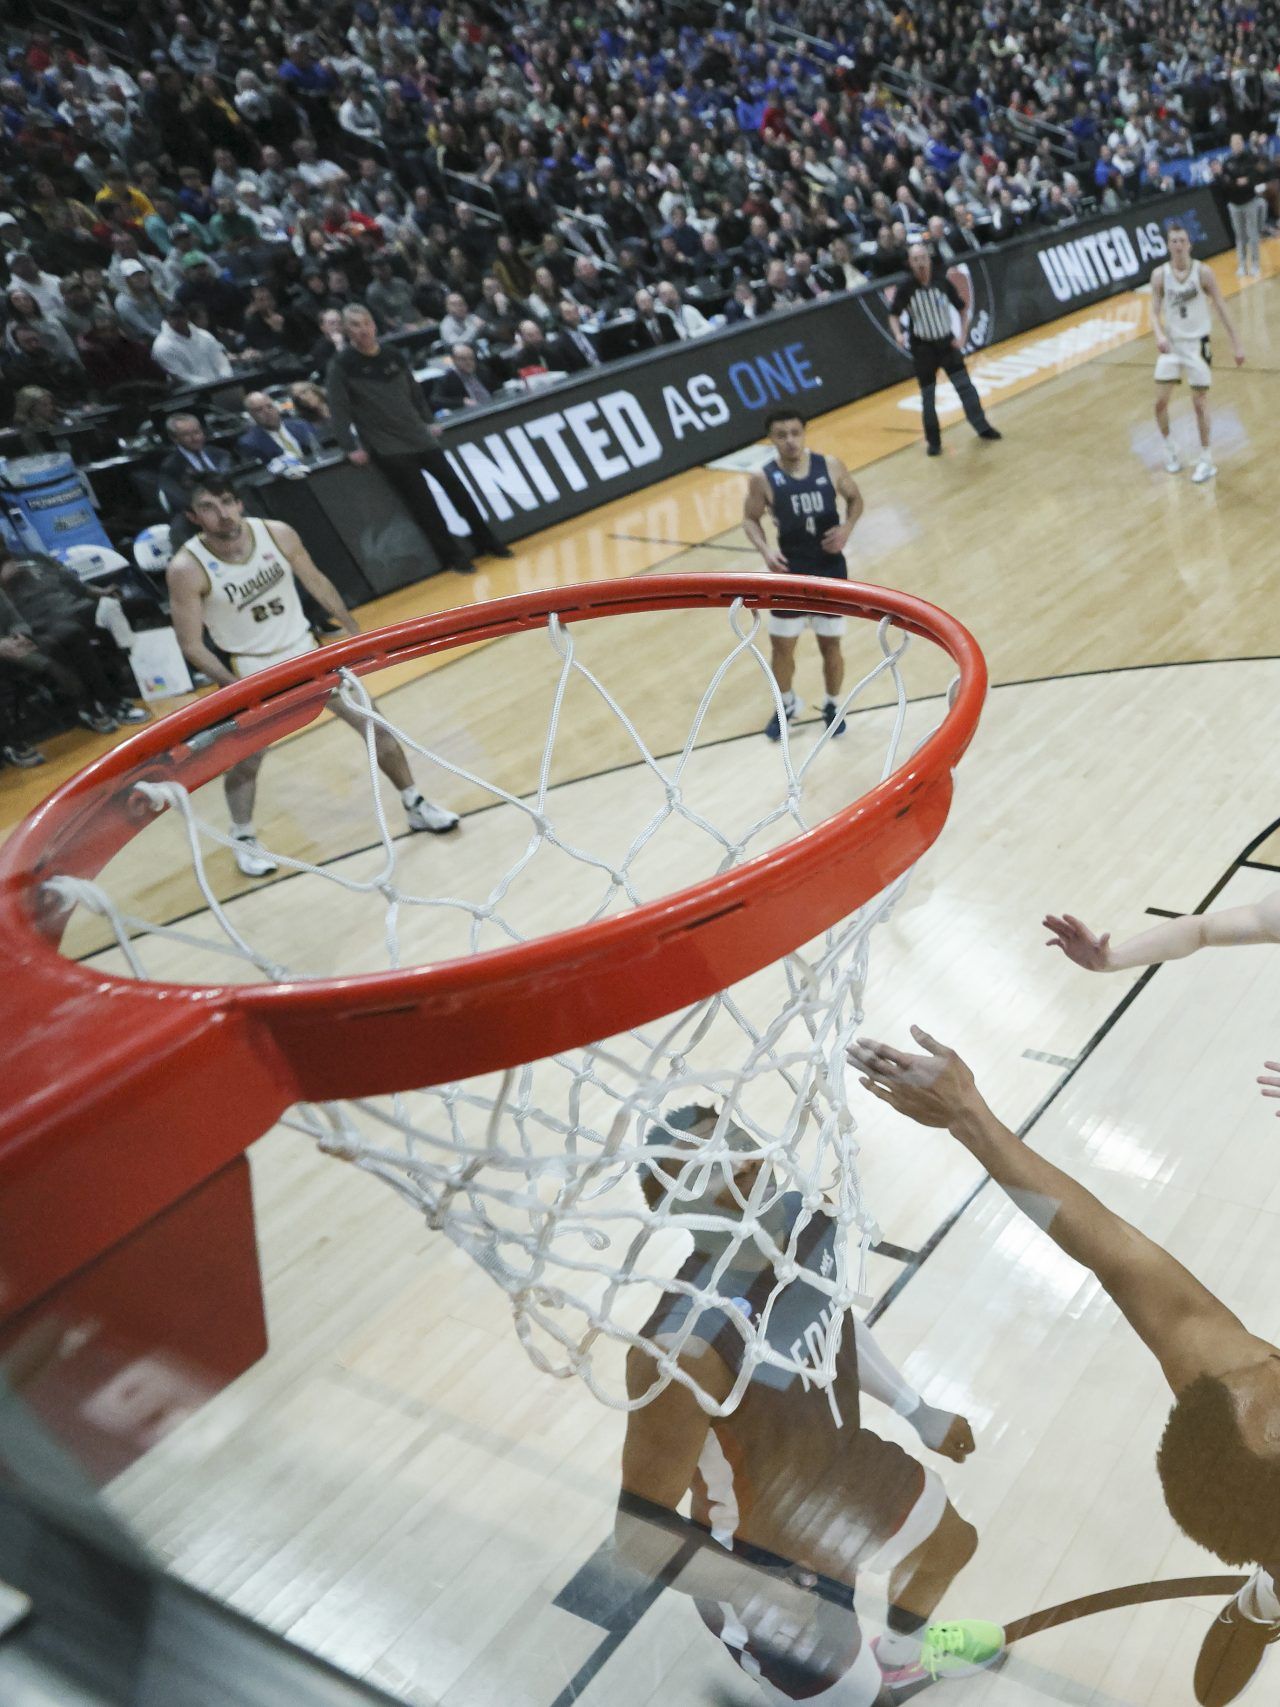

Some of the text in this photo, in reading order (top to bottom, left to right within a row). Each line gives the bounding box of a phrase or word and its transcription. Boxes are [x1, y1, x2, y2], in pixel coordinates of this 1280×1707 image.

[1038, 225, 1139, 302] UNITED
[1136, 222, 1167, 263] AS
[663, 374, 731, 439] AS
[790, 491, 824, 516] FDU
[223, 561, 285, 604] Purdue
